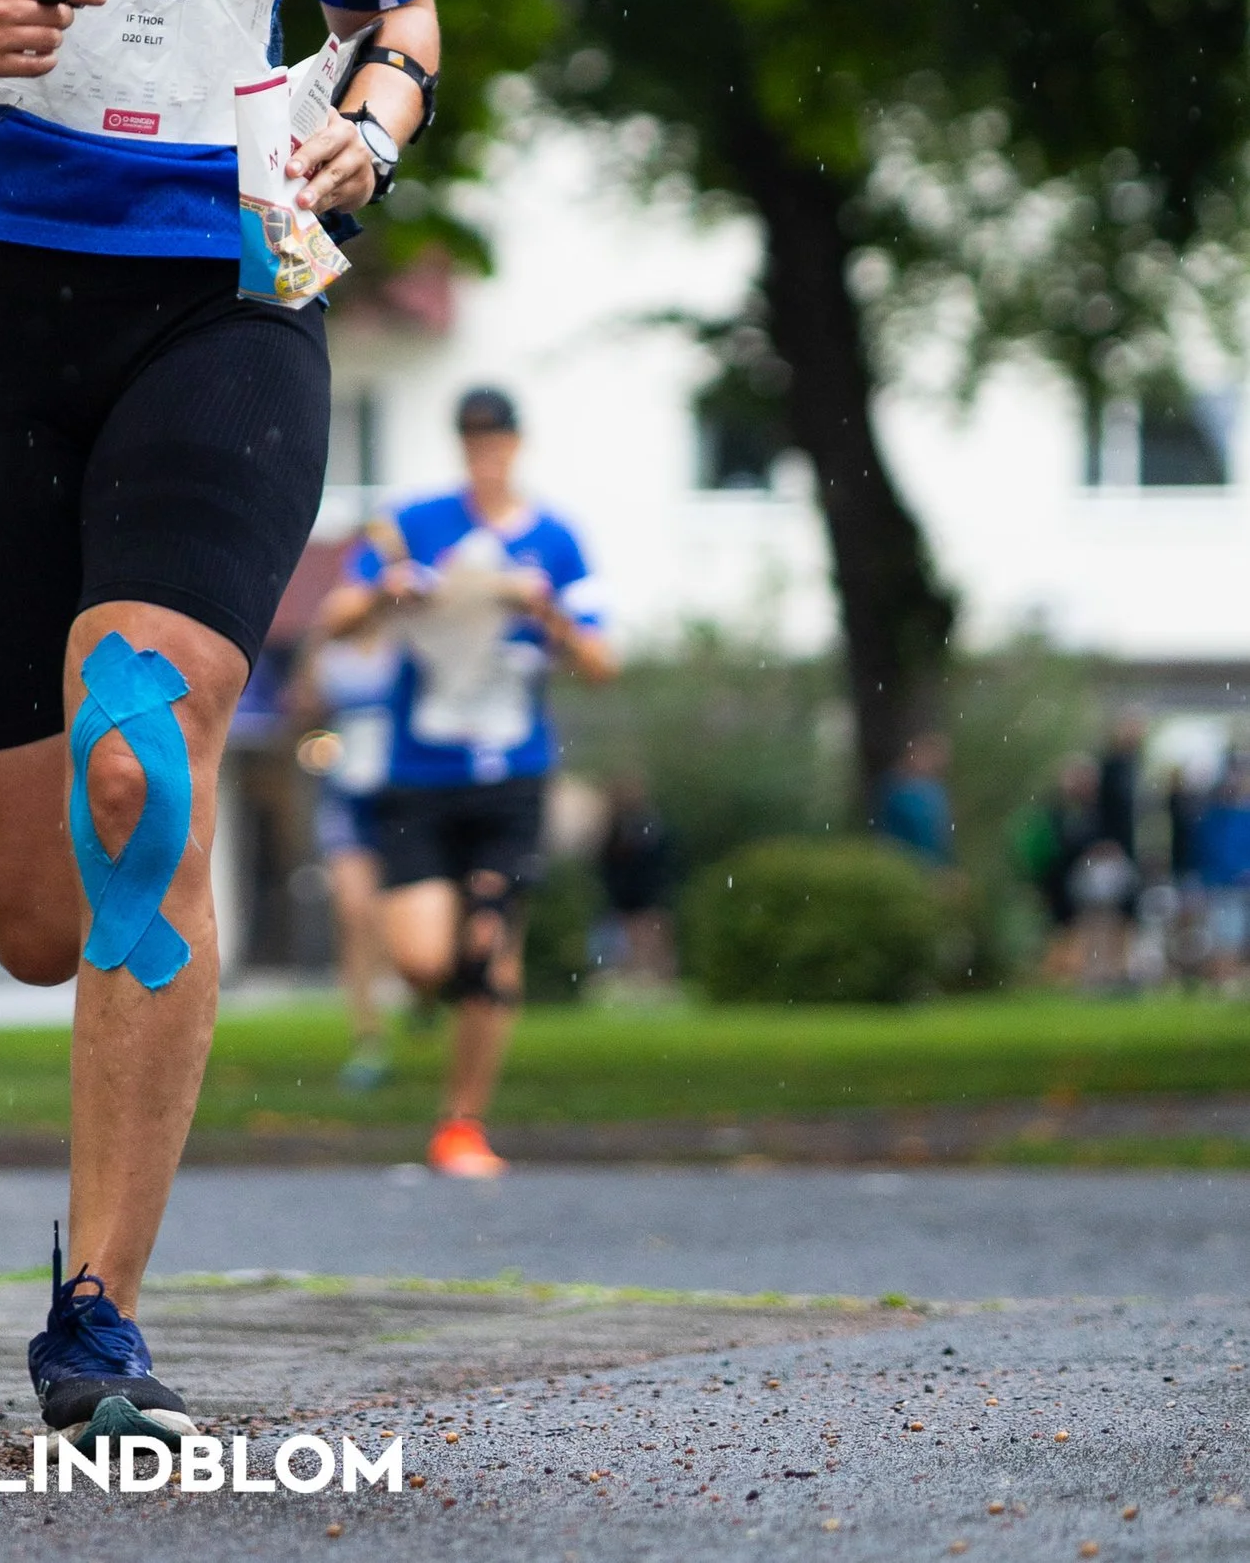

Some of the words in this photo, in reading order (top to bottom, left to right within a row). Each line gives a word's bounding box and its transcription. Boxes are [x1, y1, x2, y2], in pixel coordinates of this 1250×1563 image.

[125, 14, 135, 22] IF
[137, 15, 164, 25] THOR
[121, 33, 142, 43] D20
[144, 35, 164, 45] ELIT
